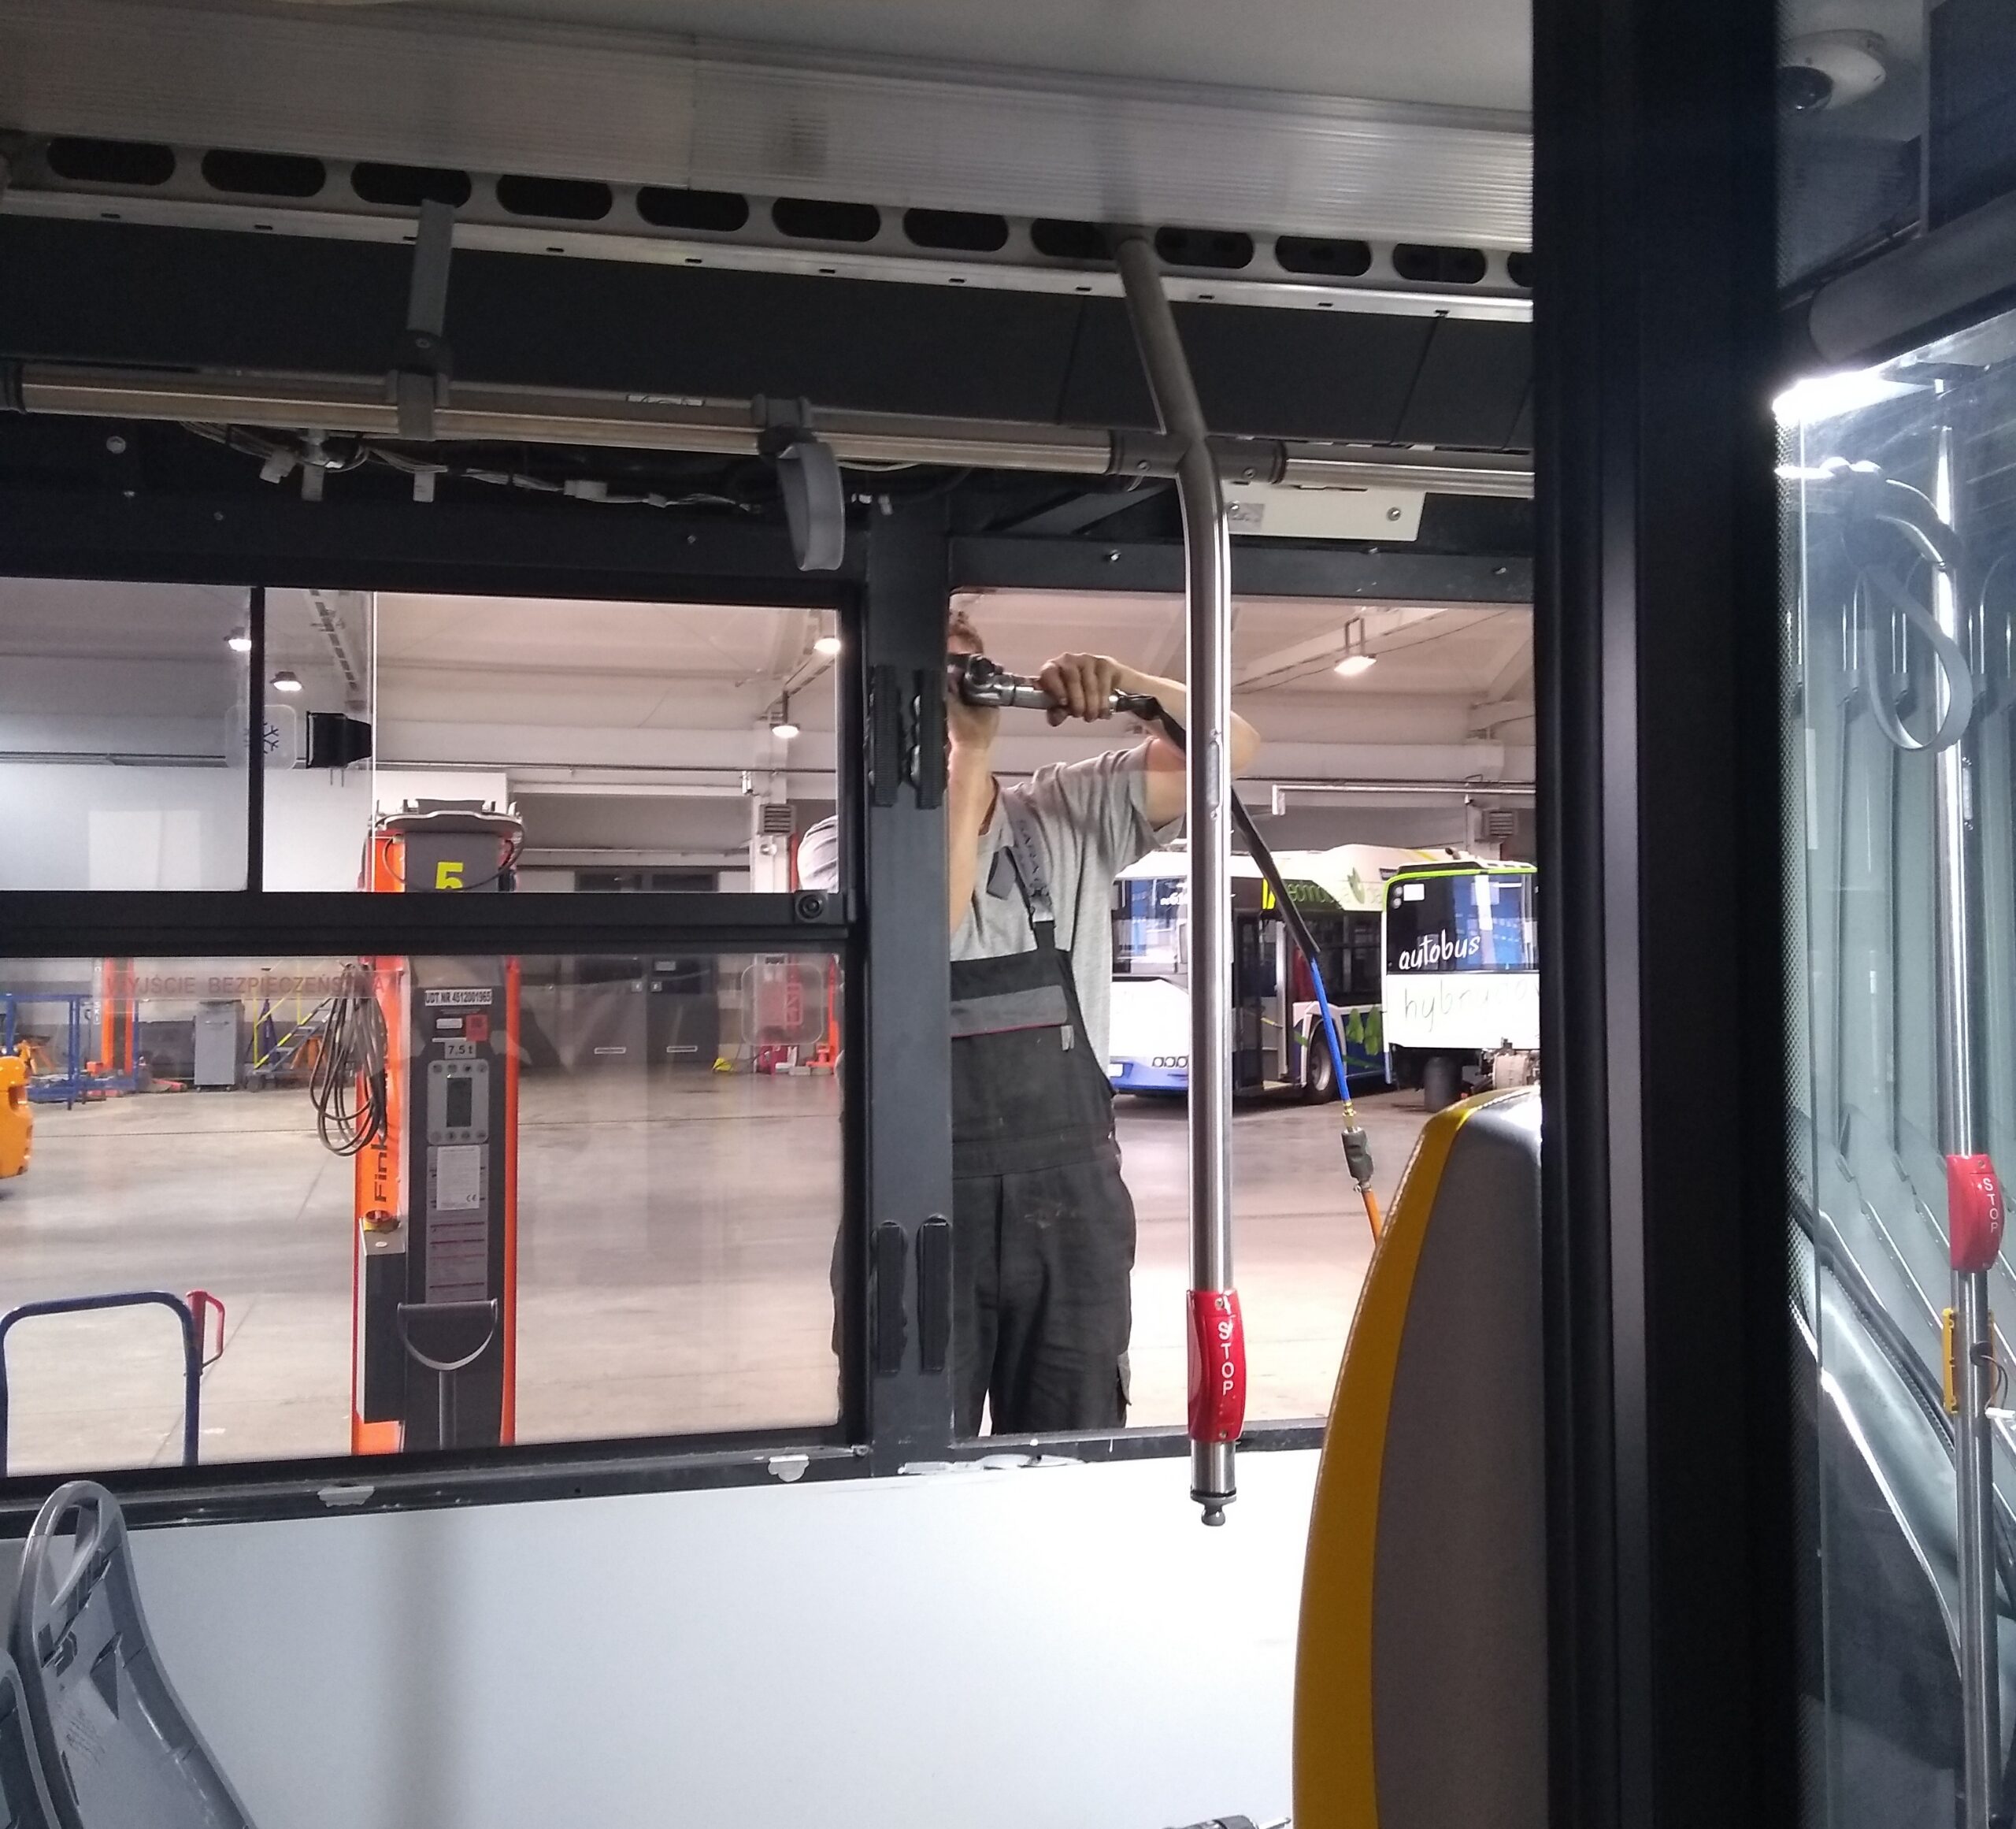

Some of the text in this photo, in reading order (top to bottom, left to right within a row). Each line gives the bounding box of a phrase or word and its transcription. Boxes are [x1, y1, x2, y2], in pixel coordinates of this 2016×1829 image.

[435, 861, 464, 889] 5
[1398, 929, 1480, 970] autobus
[209, 973, 385, 994] BEZPIECZEŃSA
[370, 1136, 387, 1203] Fink
[1983, 1178, 1999, 1234] STOP
[1217, 1320, 1236, 1396] STOP
